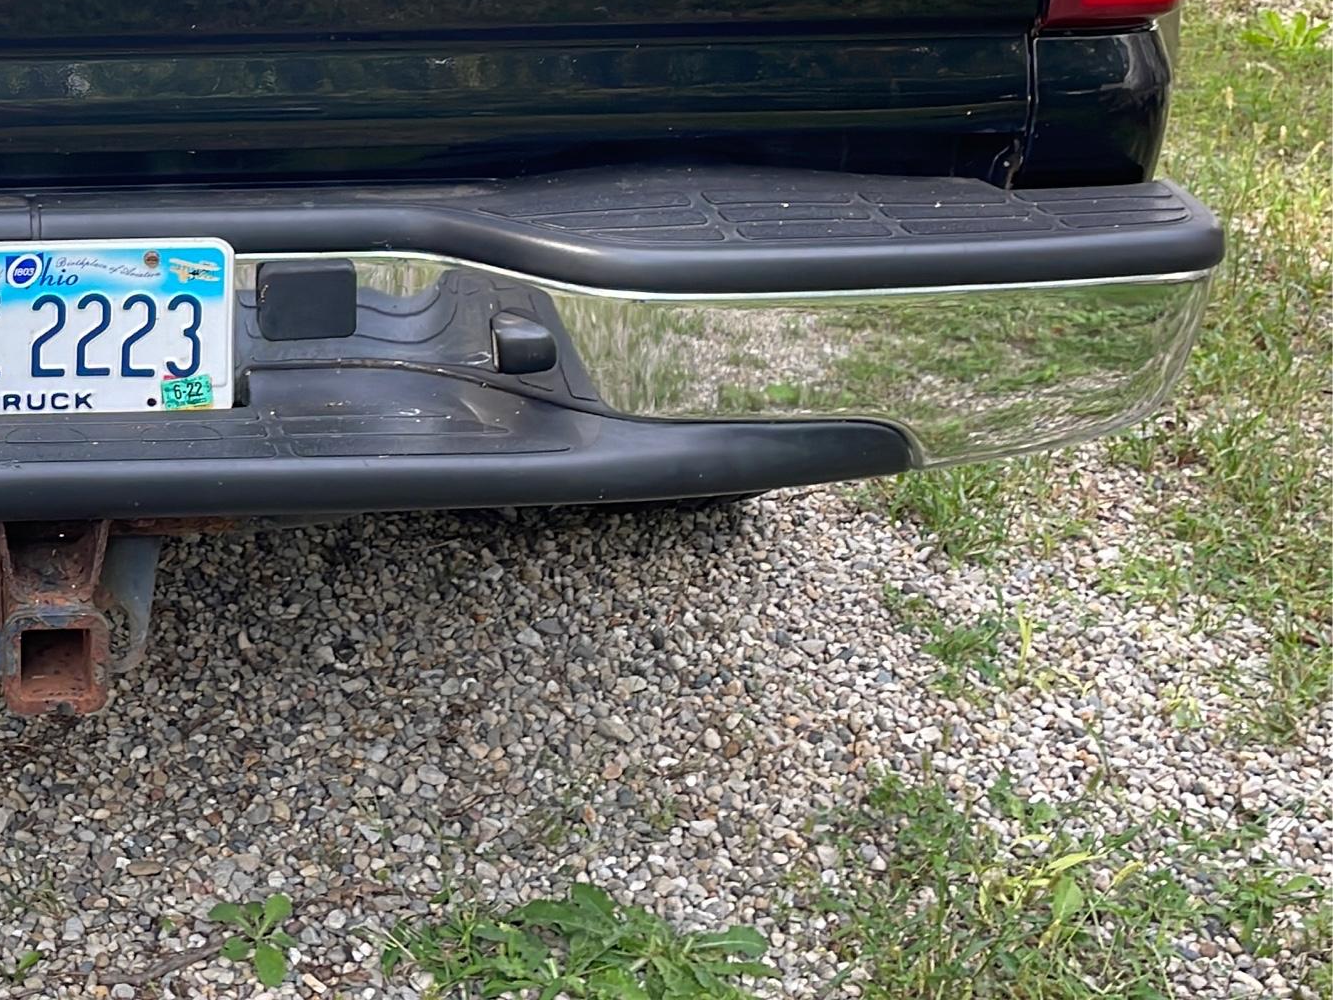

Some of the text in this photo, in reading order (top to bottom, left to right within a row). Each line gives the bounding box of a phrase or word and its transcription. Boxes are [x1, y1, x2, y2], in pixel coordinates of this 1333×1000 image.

[14, 267, 35, 277] 1803
[30, 293, 203, 378] 2223
[173, 381, 204, 400] 6-22
